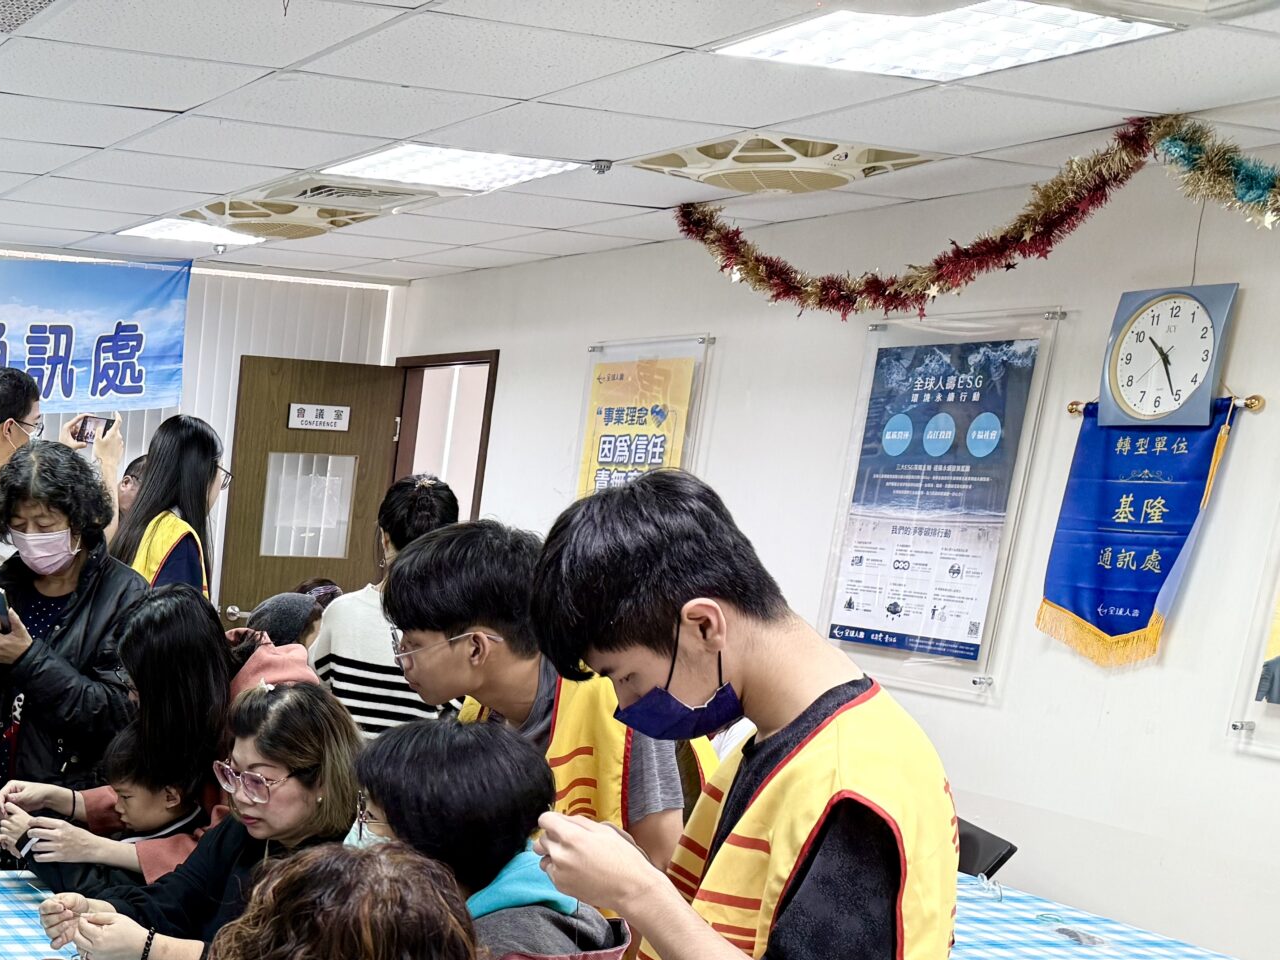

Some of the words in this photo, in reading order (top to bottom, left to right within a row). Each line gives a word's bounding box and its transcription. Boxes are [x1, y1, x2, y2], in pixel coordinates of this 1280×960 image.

[1169, 305, 1181, 318] 12
[1191, 311, 1196, 324] 1
[1151, 313, 1161, 326] 11
[1135, 330, 1146, 343] 10
[1200, 326, 1208, 339] 2
[1124, 352, 1132, 365] 9
[1201, 349, 1209, 362] 3
[1126, 375, 1134, 387] 8
[1190, 372, 1198, 385] 4
[1139, 390, 1146, 403] 7
[1153, 396, 1161, 408] 6
[1173, 389, 1182, 402] 5
[296, 407, 344, 420] 會議室
[300, 420, 338, 428] CONFERENCE
[1115, 436, 1188, 455] 轉型單位
[1112, 493, 1169, 524] 基隆
[1097, 547, 1162, 573] 通訊處
